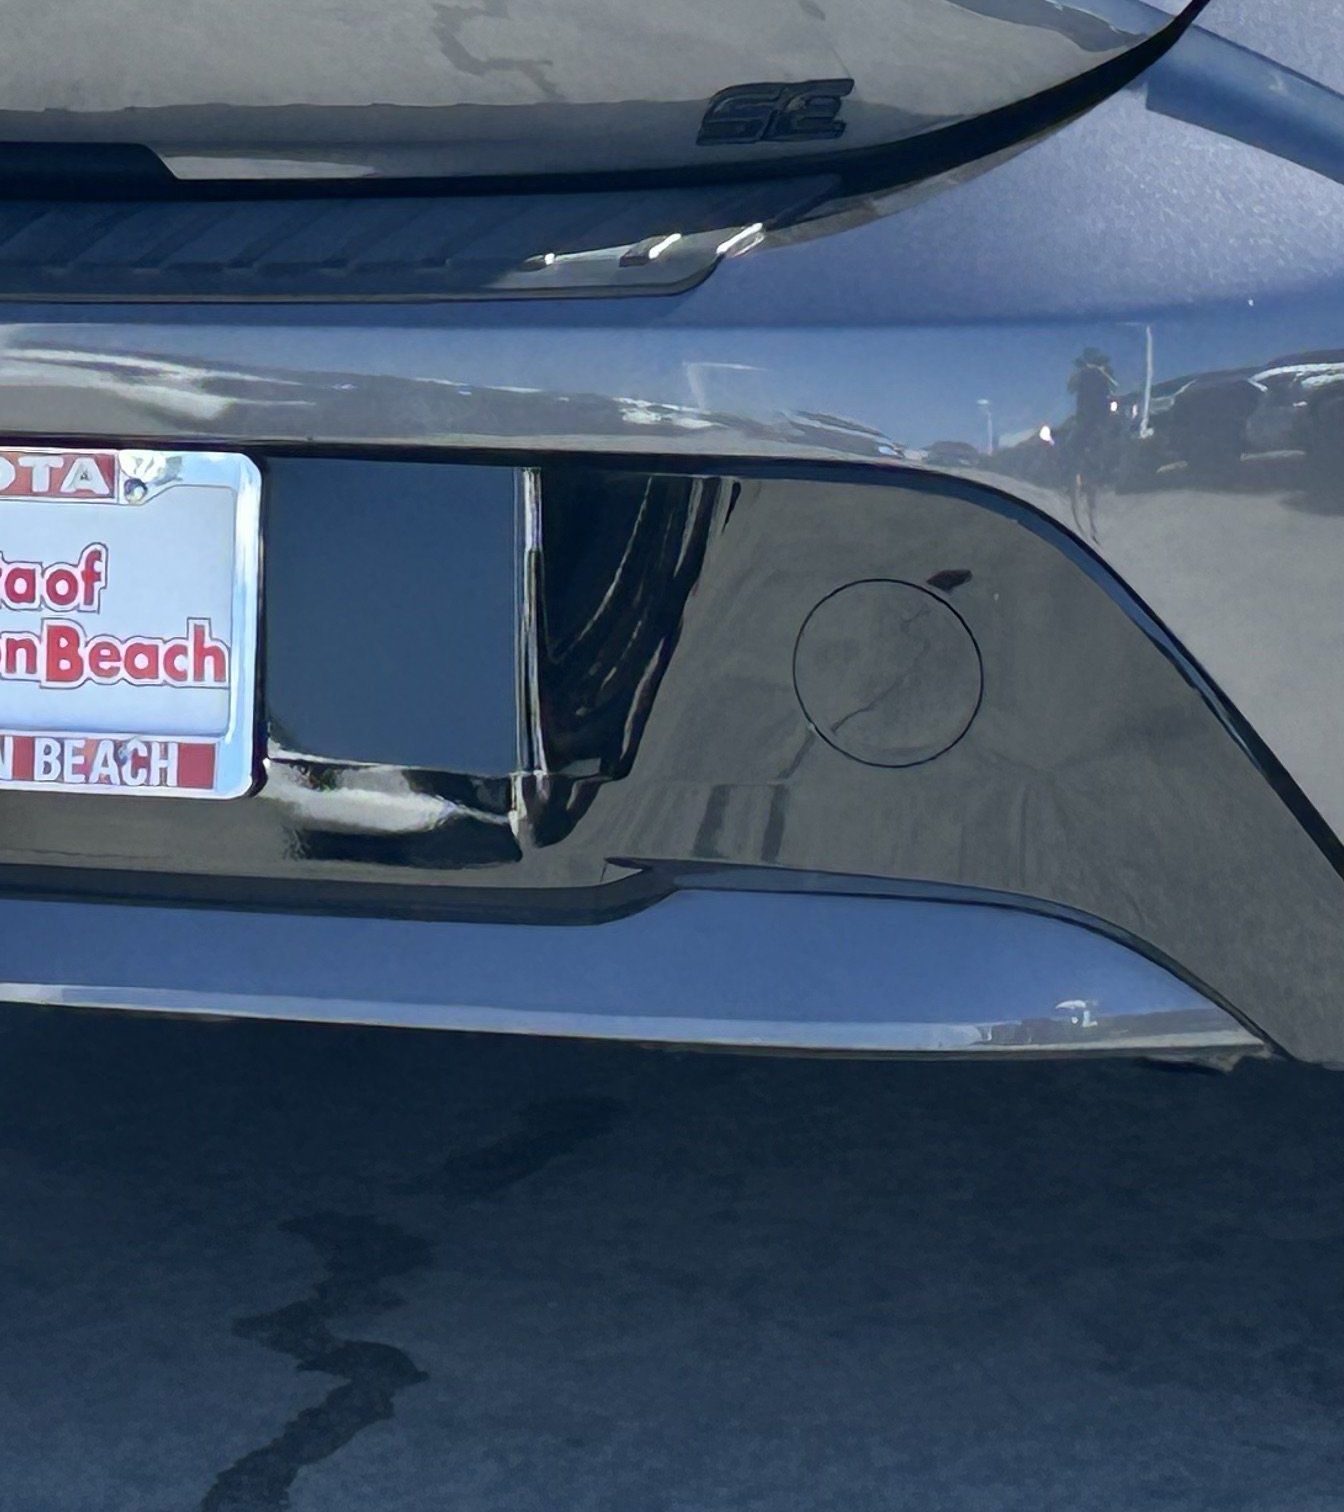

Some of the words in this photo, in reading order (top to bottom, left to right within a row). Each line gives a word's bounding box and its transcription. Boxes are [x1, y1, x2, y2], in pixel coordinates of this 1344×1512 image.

[695, 78, 855, 146] SE
[40, 546, 105, 609] of
[44, 623, 228, 686] Beach
[34, 739, 179, 788] BEACH
